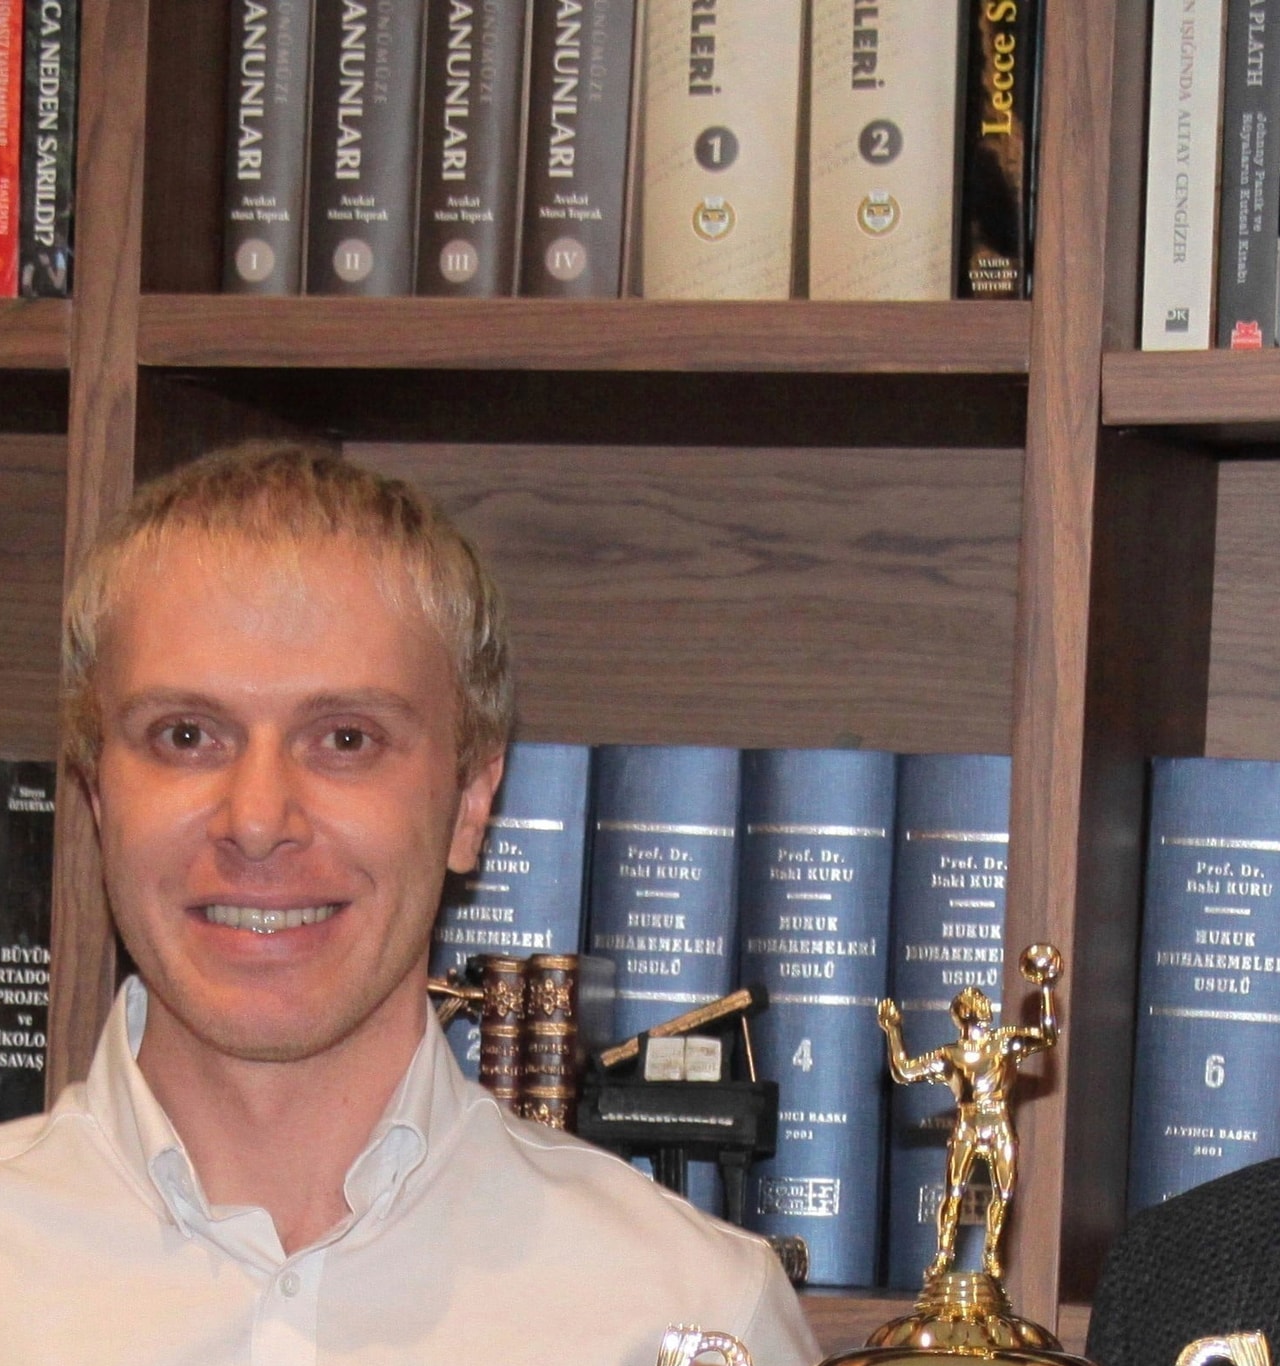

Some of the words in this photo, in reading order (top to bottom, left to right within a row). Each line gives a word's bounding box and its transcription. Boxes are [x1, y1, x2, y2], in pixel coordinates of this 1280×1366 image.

[1246, 14, 1266, 87] PLATH
[38, 44, 61, 131] NEDEN
[981, 67, 1016, 137] Lecce
[871, 127, 891, 158] 2
[1175, 110, 1193, 165] ALTAY
[707, 136, 723, 164] 1
[33, 138, 60, 246] SARILDI?
[1171, 172, 1190, 265] CENGİZER
[251, 251, 258, 272] I
[345, 251, 361, 272] II
[446, 251, 470, 273] III
[553, 250, 577, 271] IV
[626, 844, 663, 863] Prof.
[669, 848, 695, 862] Dr.
[776, 847, 814, 864] Prof.
[820, 850, 847, 865] Dr.
[938, 854, 976, 872] Prof.
[983, 857, 1009, 872] Dr.
[485, 857, 531, 875] KURU
[655, 865, 703, 883] KURU
[807, 867, 855, 883] KURU
[1195, 861, 1235, 878] Prof.
[1240, 863, 1266, 880] Dr.
[1226, 881, 1274, 899] KURU
[456, 906, 516, 924] HUKUK
[626, 912, 687, 931] HUKUK
[778, 915, 840, 932] HUKUK
[941, 922, 1002, 941] HUKUK
[1194, 929, 1257, 949] HUKUK
[593, 934, 725, 958] MUHAKEMELERİ
[747, 937, 878, 958] MUHAKEMELERİ
[625, 958, 682, 977] USULÜ
[779, 961, 837, 980] USULÜ
[940, 968, 1000, 988] USULÜ
[1192, 975, 1252, 996] USULÜ
[17, 1013, 33, 1027] ve
[790, 1036, 815, 1074] 4
[1203, 1052, 1227, 1090] 6
[1219, 1127, 1260, 1144] BASKI
[1192, 1144, 1224, 1158] 2001
